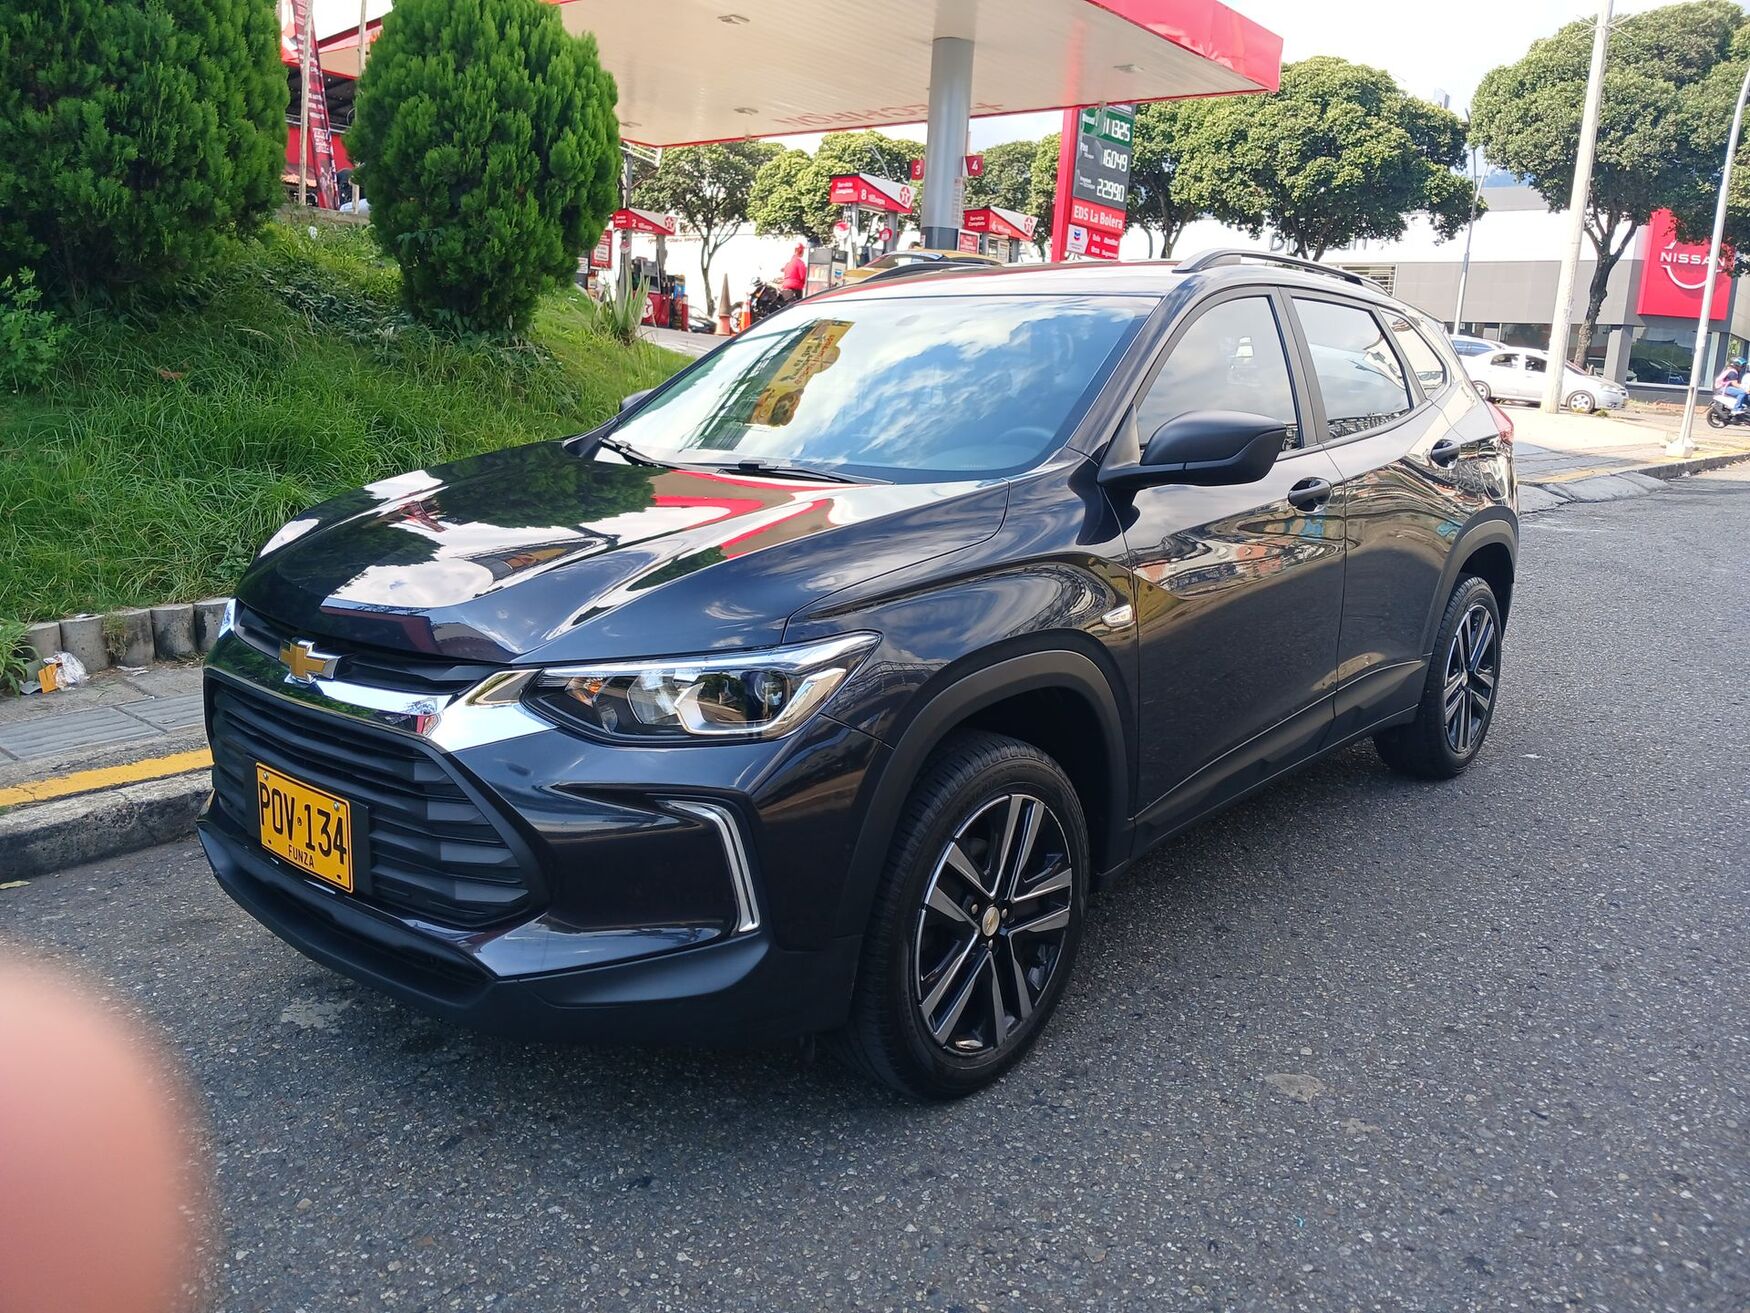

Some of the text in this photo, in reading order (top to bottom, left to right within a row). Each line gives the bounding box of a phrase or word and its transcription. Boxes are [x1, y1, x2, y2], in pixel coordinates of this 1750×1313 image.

[971, 160, 979, 171] 4
[1103, 149, 1128, 173] 16049
[915, 164, 921, 175] 3
[861, 189, 867, 201] 8
[1096, 178, 1125, 202] 22990
[631, 219, 637, 228] 2
[1073, 205, 1123, 229] EDS La Bolera
[991, 221, 998, 231] 6
[1660, 252, 1726, 267] NISSAN
[288, 844, 315, 869] FUNZA
